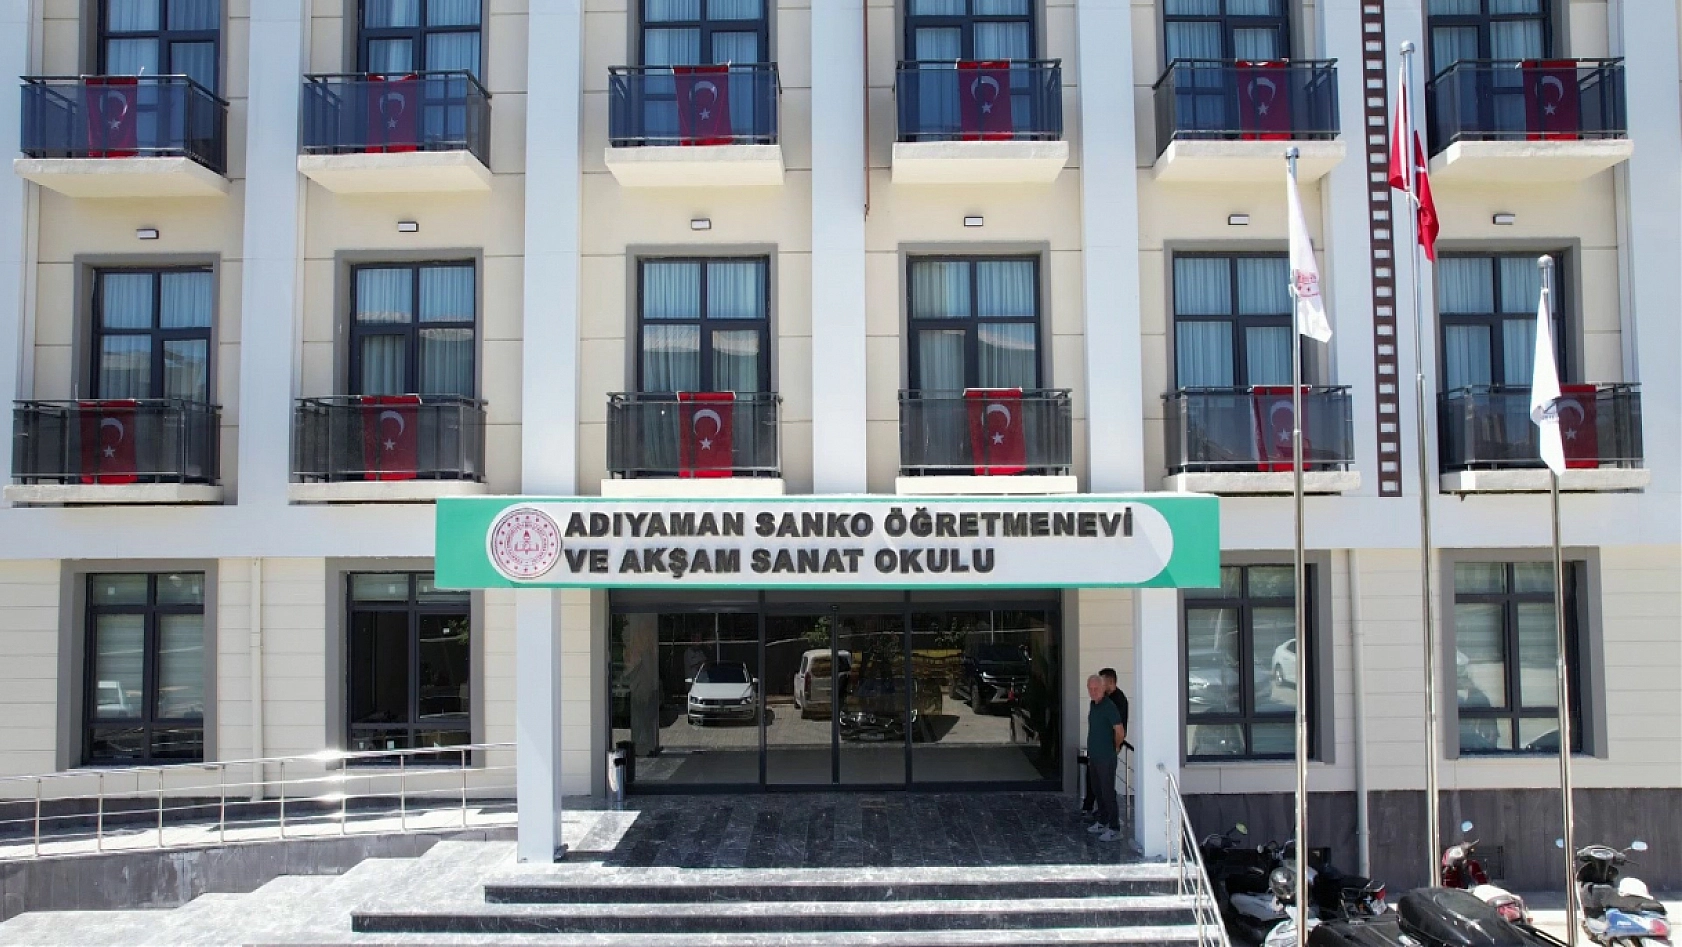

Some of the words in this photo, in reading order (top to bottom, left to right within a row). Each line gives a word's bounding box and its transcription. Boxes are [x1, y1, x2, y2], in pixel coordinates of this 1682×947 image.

[565, 512, 743, 537] ADIYAMAN
[755, 512, 873, 537] SANKO
[884, 507, 1133, 537] ÖĞRETMENEVİ
[565, 548, 609, 573] VE
[619, 548, 740, 578] AKŞAM
[751, 548, 864, 573] SANAT
[874, 548, 994, 573] OKULU
